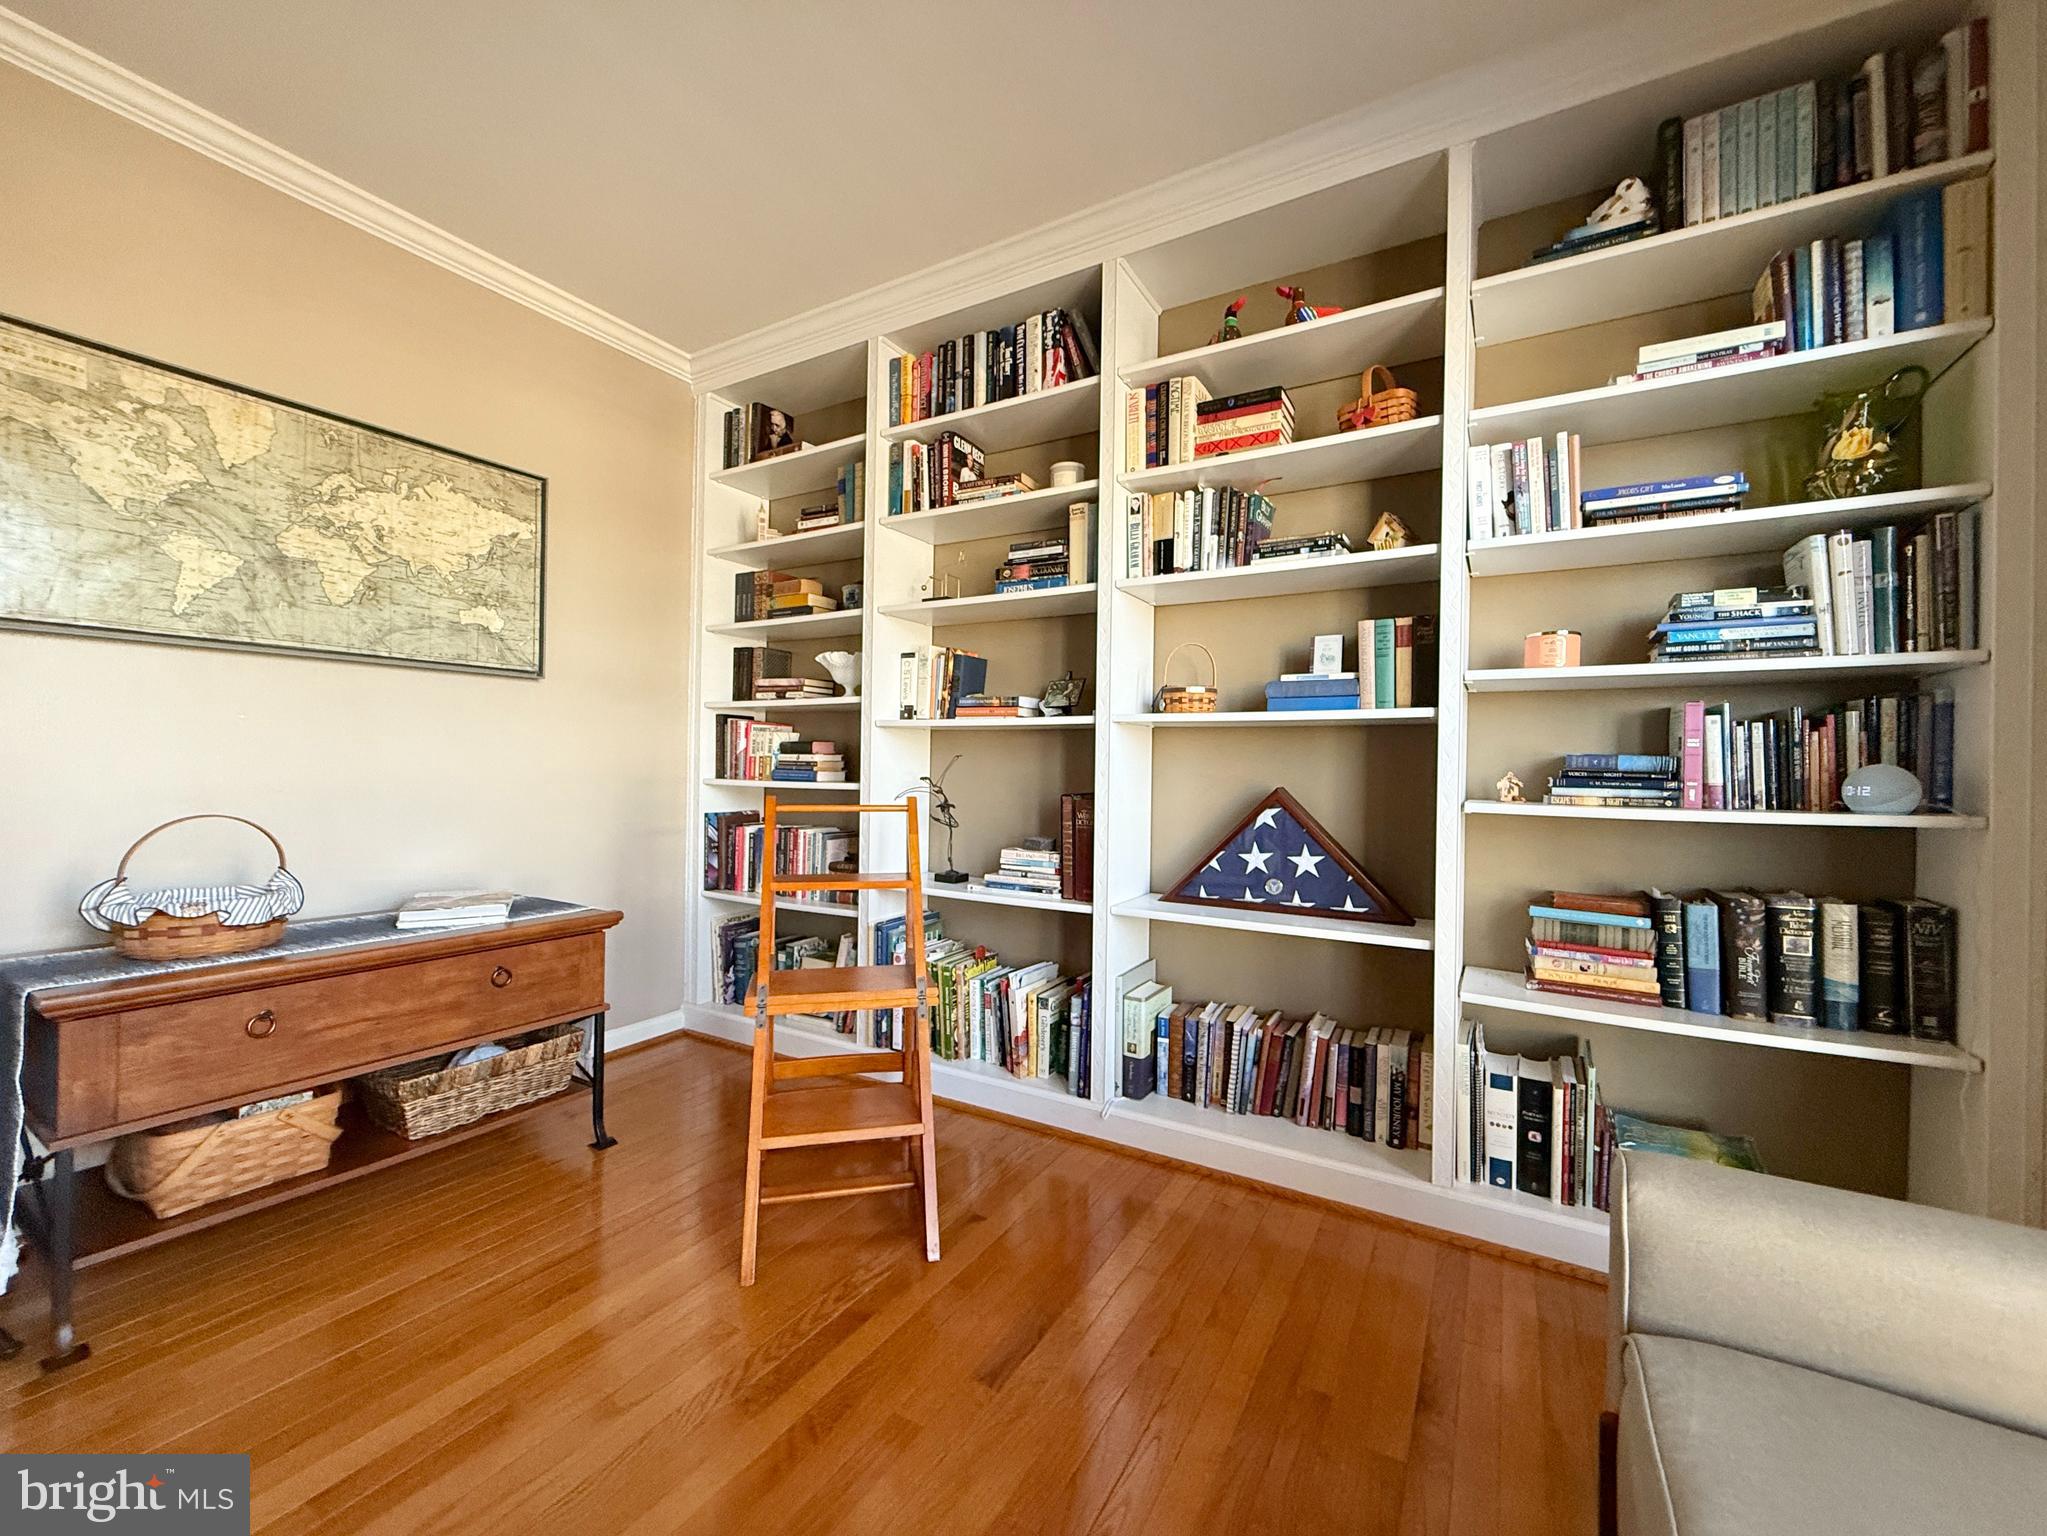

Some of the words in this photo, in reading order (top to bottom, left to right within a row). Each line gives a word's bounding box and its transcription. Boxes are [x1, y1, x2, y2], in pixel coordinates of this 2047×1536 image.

[1654, 369, 1677, 379] CHURCH
[1678, 362, 1713, 374] AWAKENING
[1170, 380, 1180, 416] RAGTIME
[953, 435, 971, 455] GLENN
[972, 446, 985, 466] BECK
[1616, 516, 1632, 525] WITH
[1640, 514, 1659, 523] CAUSE
[1664, 509, 1694, 519] FRANKLIN
[1695, 507, 1720, 517] GRAHAM
[1129, 522, 1141, 540] BILLY
[1194, 520, 1200, 533] Am
[1130, 541, 1140, 569] GRAHAM
[1678, 613, 1705, 621] YOUNG
[1731, 609, 1761, 618] SHACK
[1676, 631, 1715, 641] YANCEY
[1665, 644, 1682, 653] WHAT
[1683, 644, 1700, 652] GOOD
[1700, 643, 1708, 652] IS
[1708, 643, 1725, 651] GOD?
[1753, 640, 1771, 648] PHILIP
[1772, 639, 1799, 647] YANCEY
[1551, 796, 1570, 804] ESCAPE
[1606, 798, 1624, 806] NIGHT
[1779, 928, 1814, 937] Dictionary
[1789, 922, 1808, 930] Bible
[1911, 923, 1941, 935] NIV
[1831, 920, 1853, 951] MESSAGE
[1738, 956, 1746, 979] BIBLE
[1069, 1031, 1079, 1073] Entertaining
[1393, 1081, 1402, 1095] MY
[1391, 1096, 1402, 1138] JOURNEY
